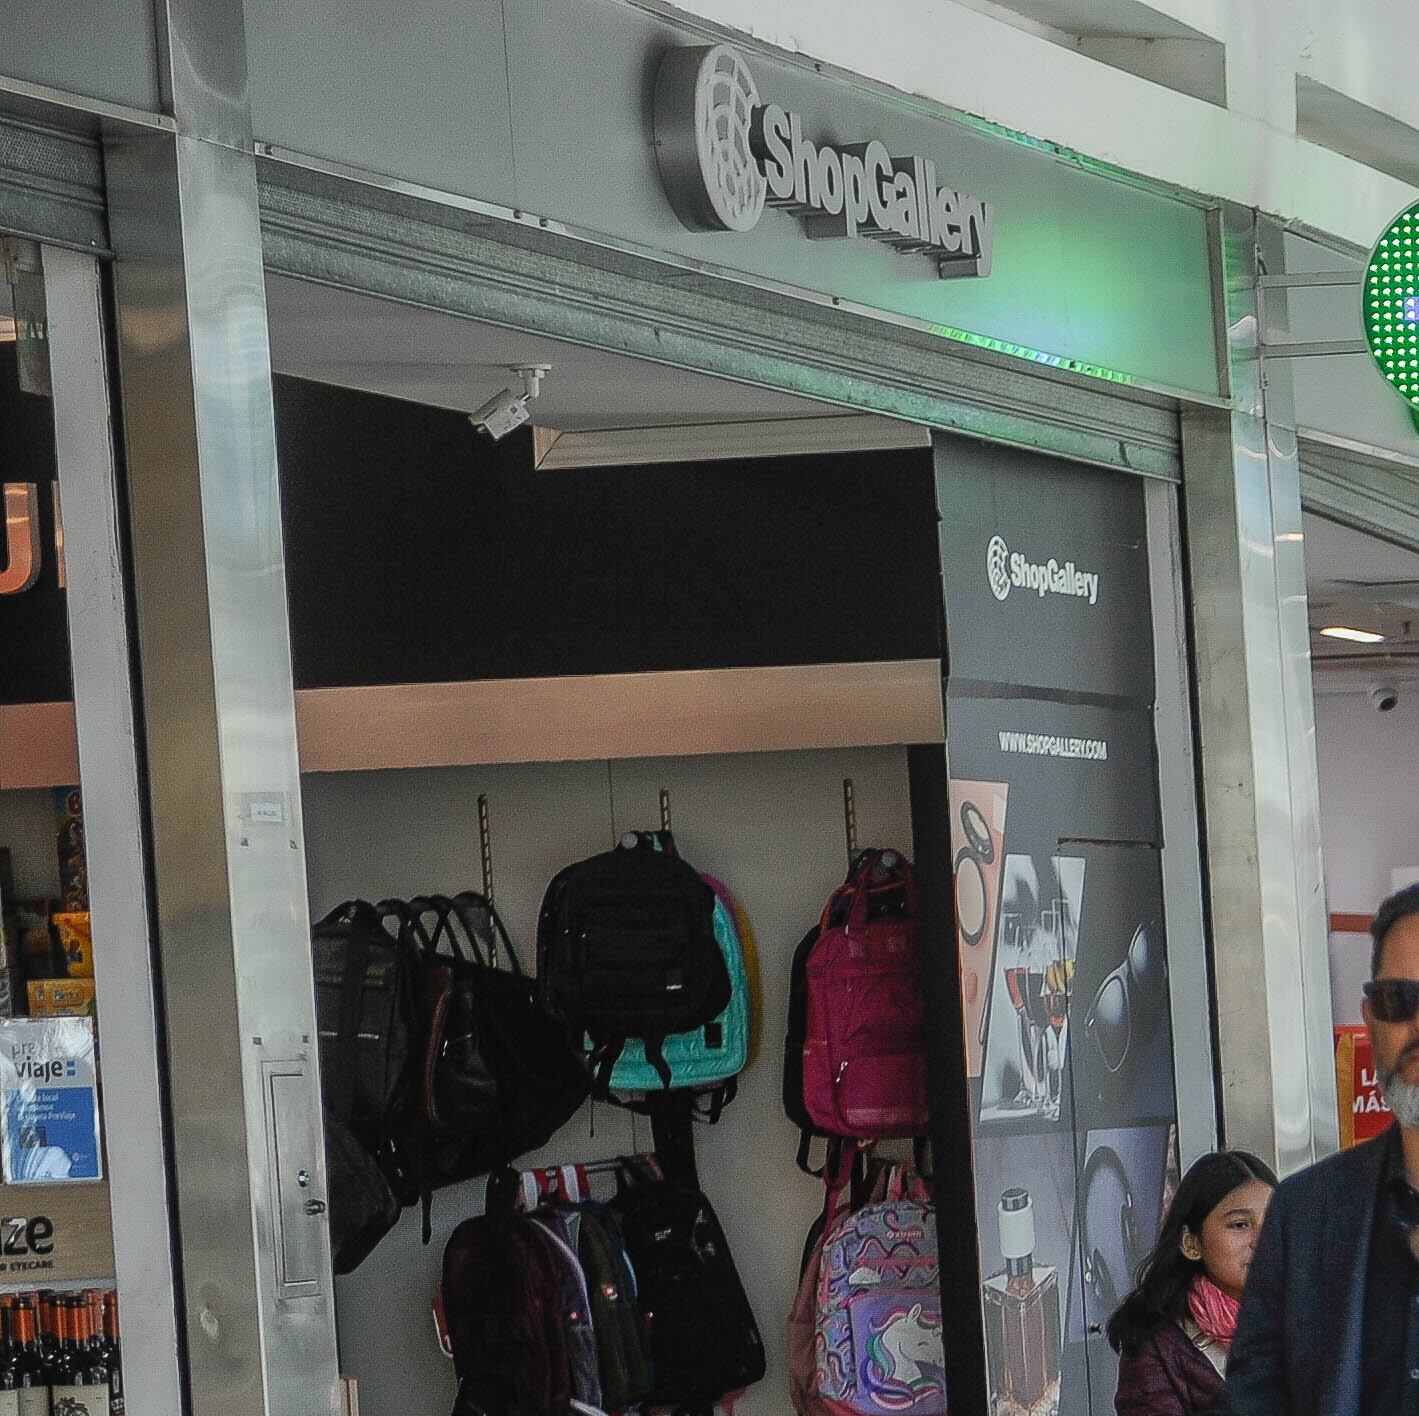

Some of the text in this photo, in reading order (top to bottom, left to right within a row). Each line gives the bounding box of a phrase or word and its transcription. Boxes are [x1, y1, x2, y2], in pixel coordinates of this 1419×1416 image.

[763, 104, 994, 277] ShopGallery
[1010, 552, 1099, 605] ShopGallery
[999, 731, 1108, 760] WWW.SHOPGALLERY.COM
[16, 1056, 63, 1082] viaje
[0, 1215, 54, 1255] ze
